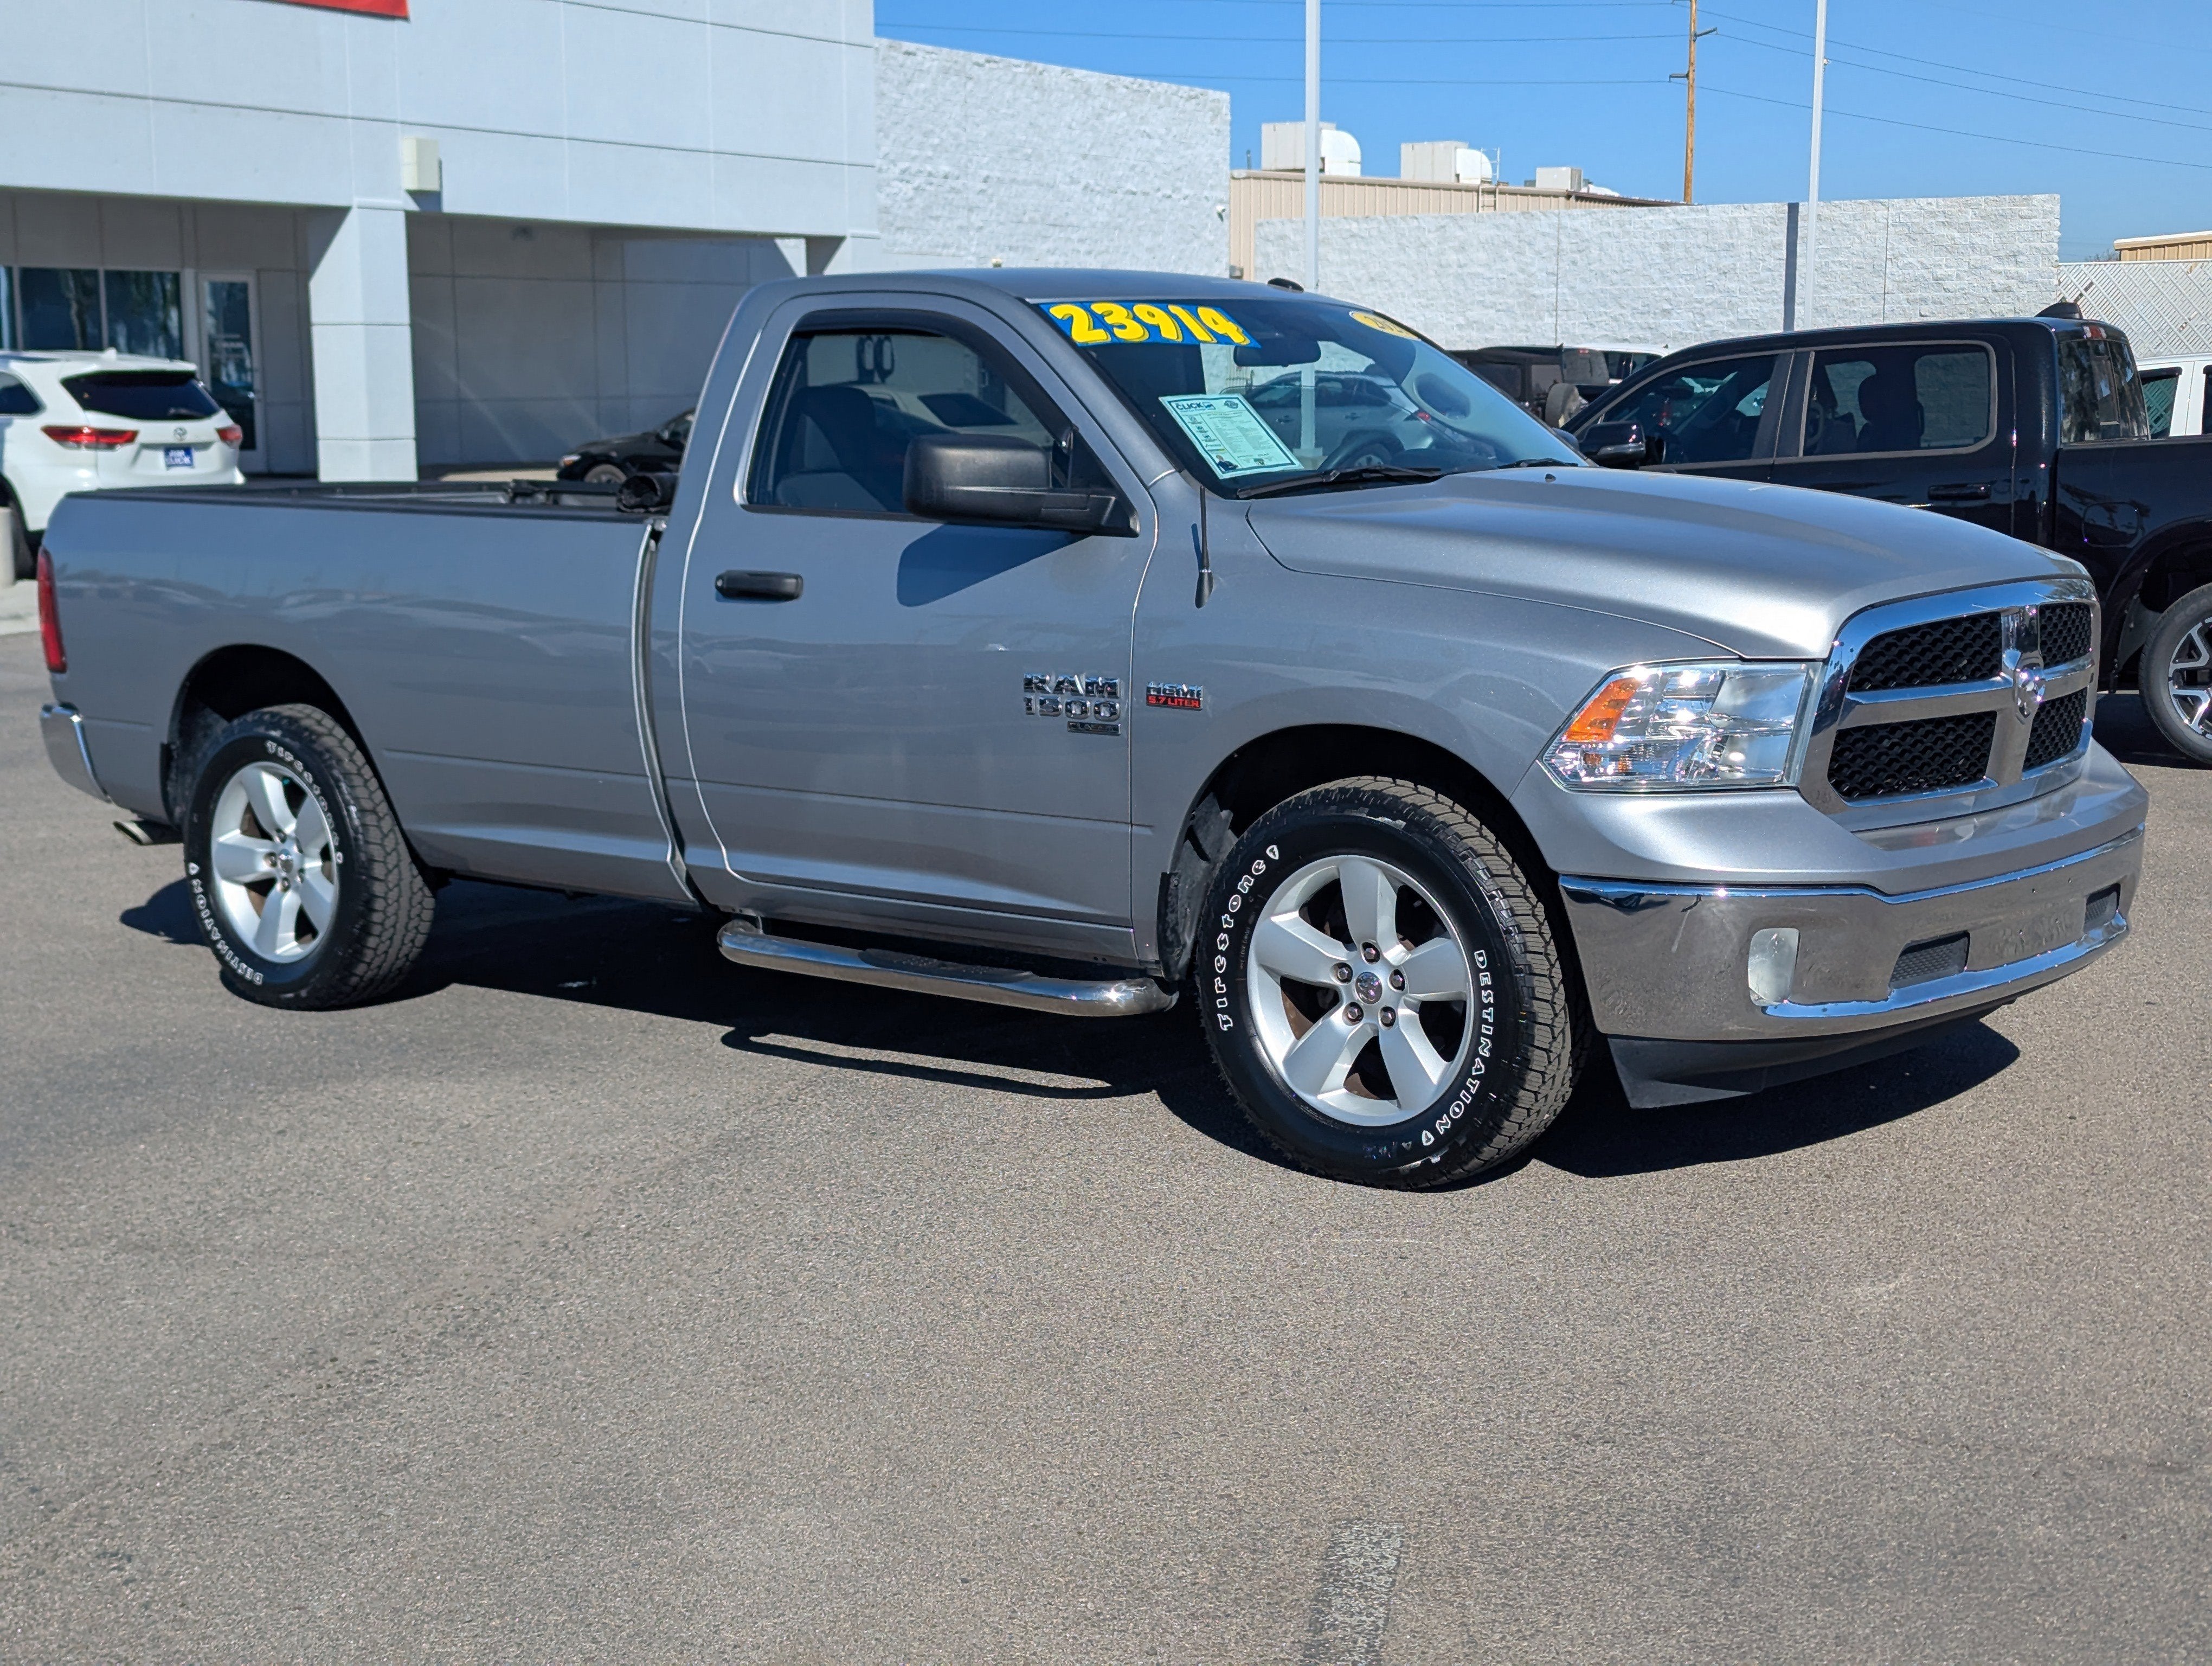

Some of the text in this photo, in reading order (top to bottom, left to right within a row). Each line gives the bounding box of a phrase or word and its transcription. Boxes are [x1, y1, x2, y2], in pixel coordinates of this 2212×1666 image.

[1050, 302, 1251, 345] 23914
[1175, 402, 1204, 411] CLICK
[1023, 672, 1120, 699] RAM
[1024, 695, 1121, 722] 1500
[1148, 696, 1199, 708] 5.7 LITER
[1214, 859, 1266, 1031] Firestone
[1435, 950, 1494, 1136] DESTINATION
